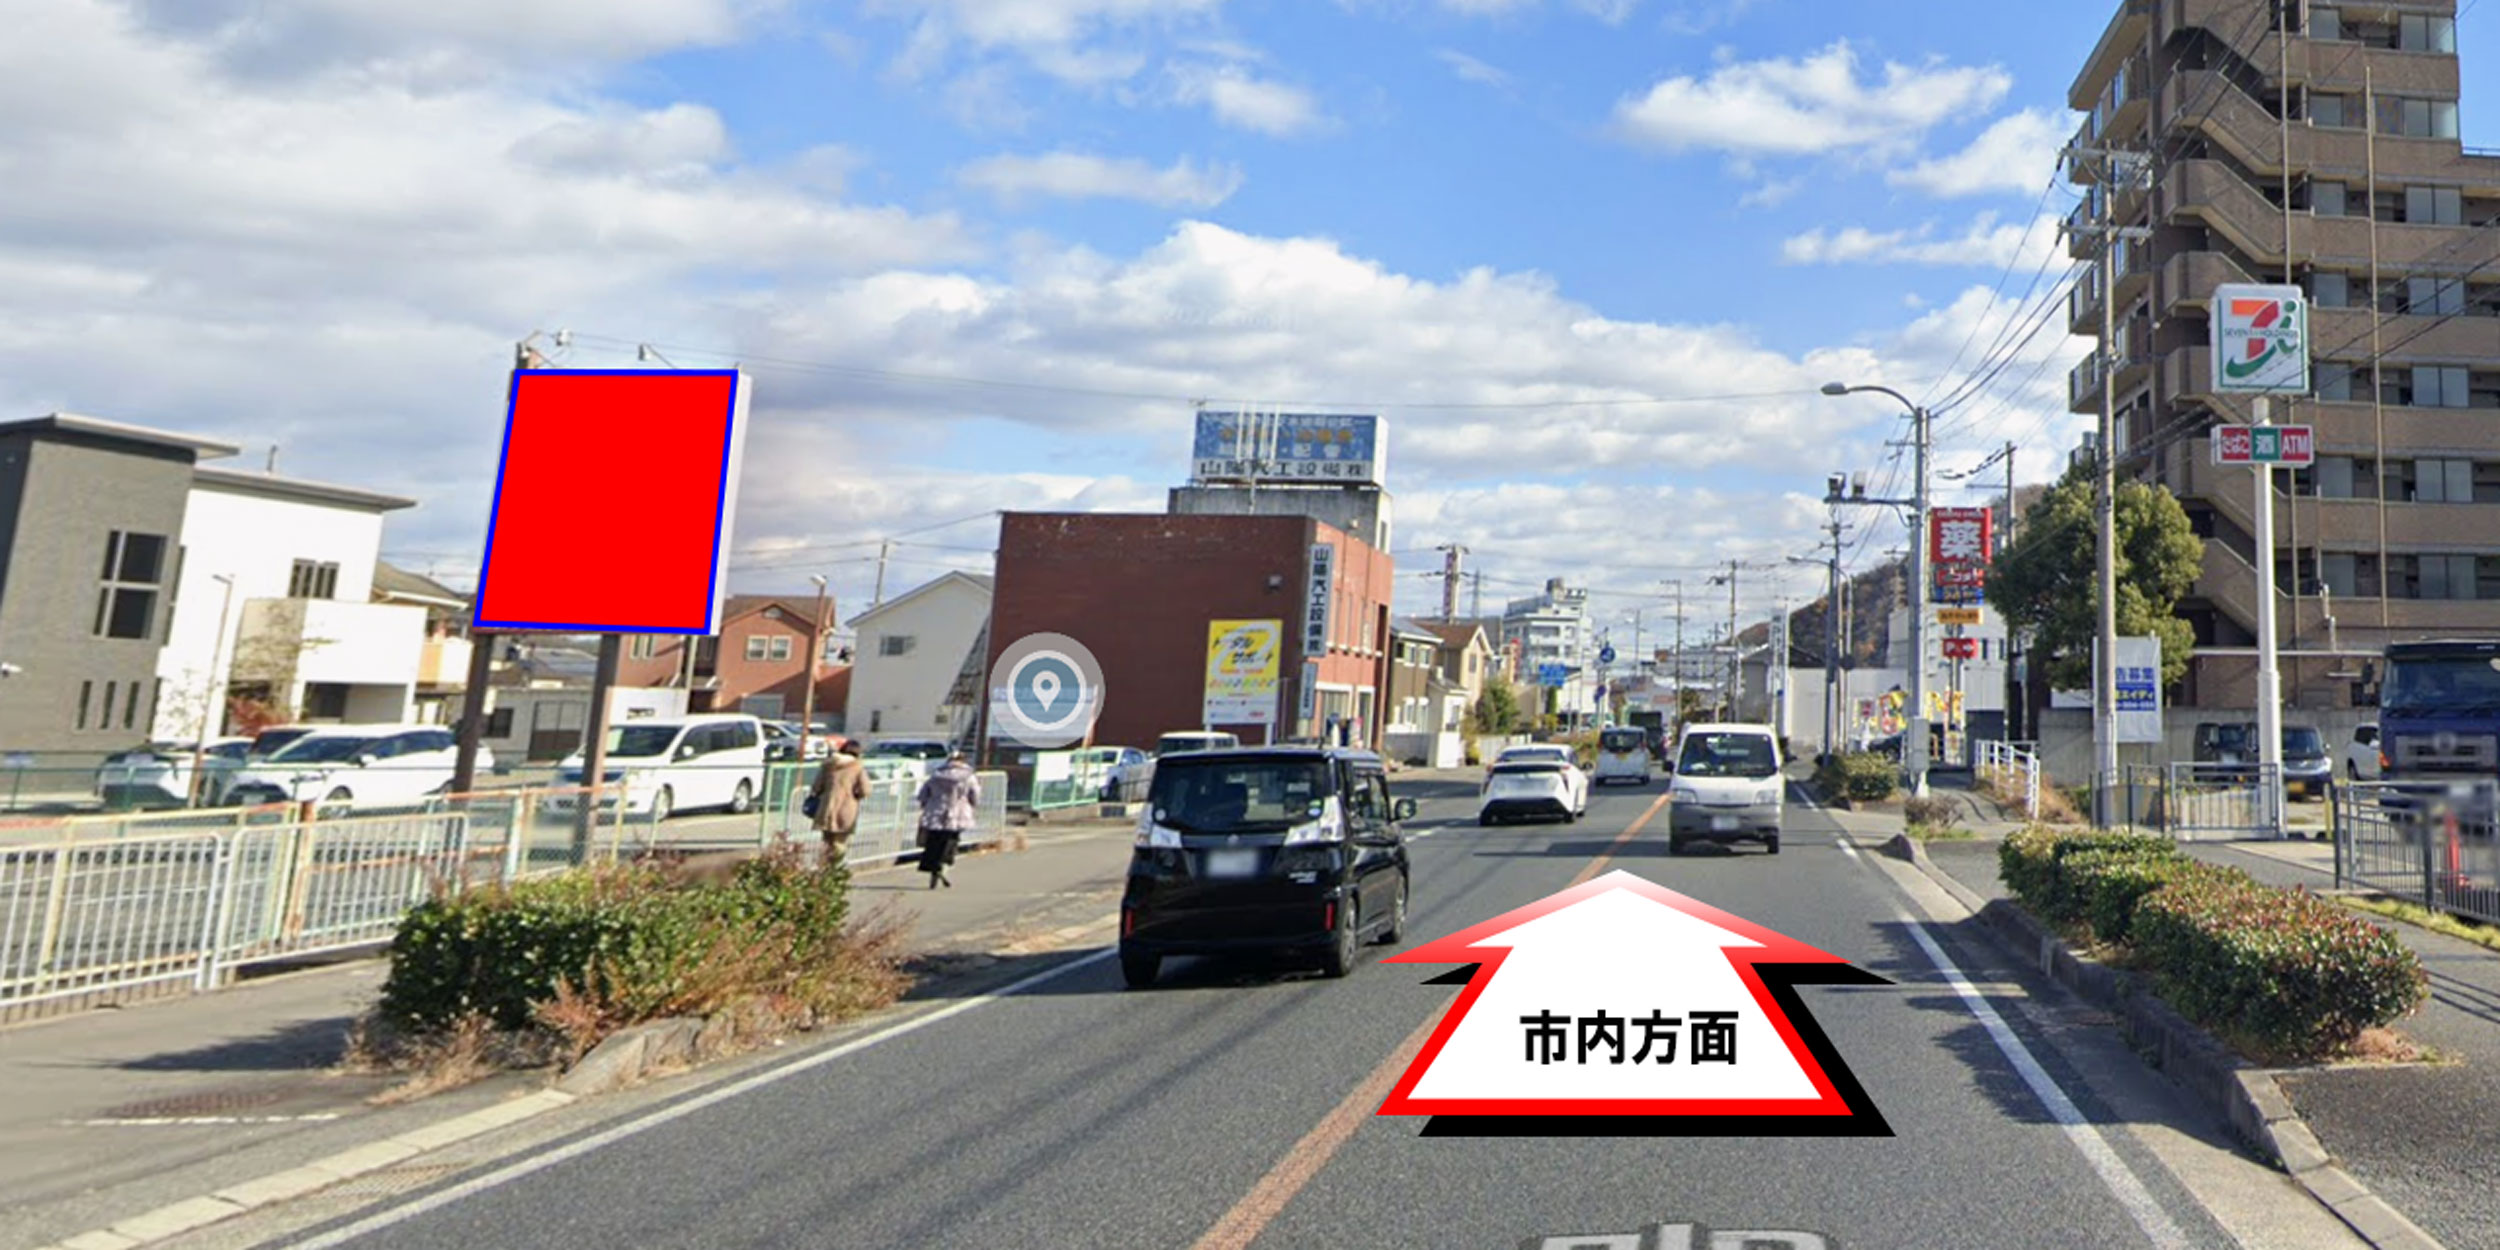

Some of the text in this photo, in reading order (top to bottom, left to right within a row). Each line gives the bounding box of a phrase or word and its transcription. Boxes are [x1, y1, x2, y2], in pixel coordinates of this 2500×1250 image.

[2255, 434, 2275, 455] 酒
[2282, 434, 2309, 455] ATM
[1940, 520, 1982, 559] 薬
